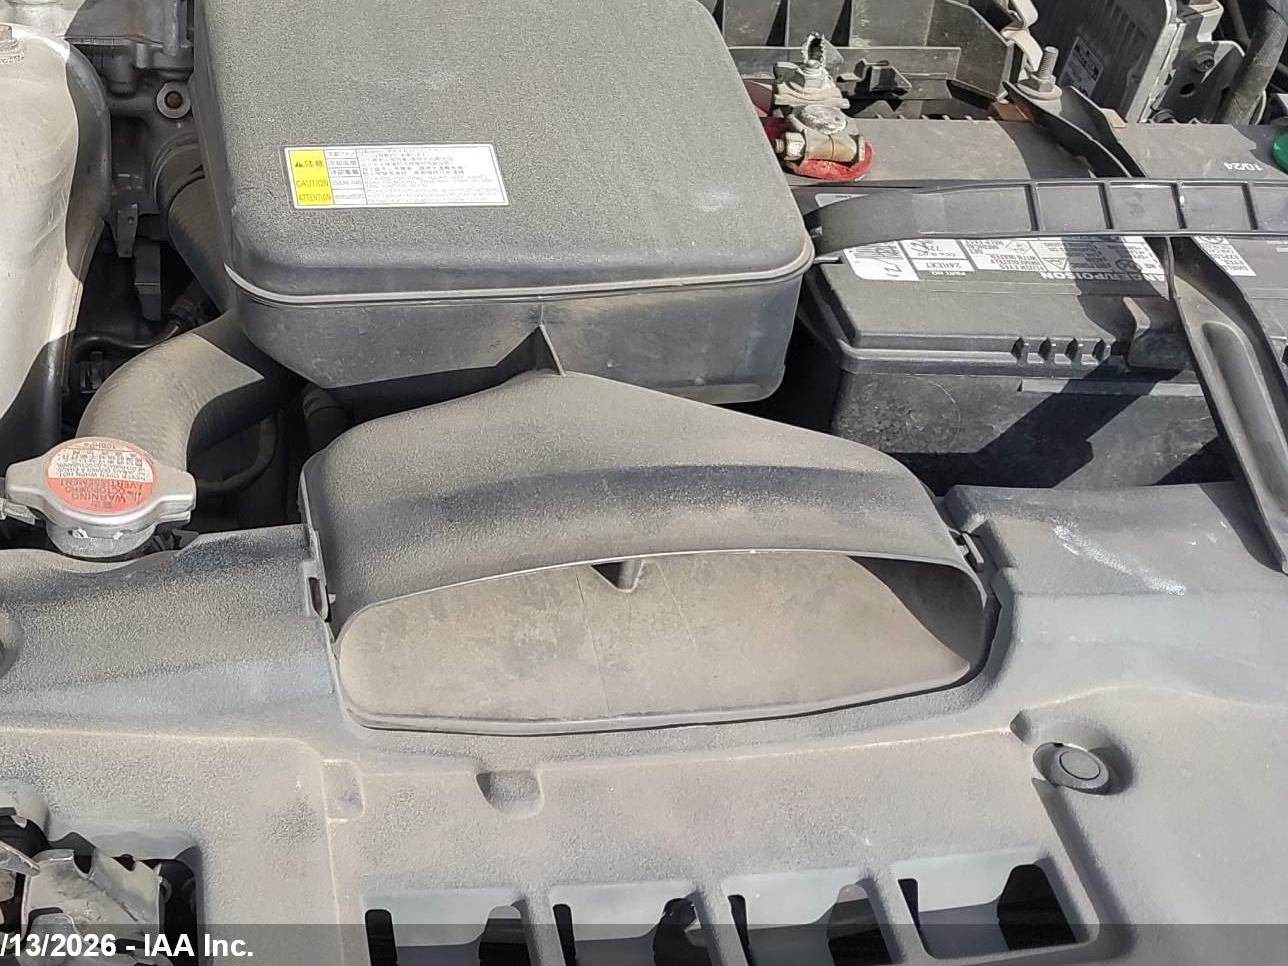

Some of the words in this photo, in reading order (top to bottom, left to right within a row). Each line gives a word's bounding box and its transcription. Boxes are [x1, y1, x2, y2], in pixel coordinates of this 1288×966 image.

[1223, 161, 1264, 172] 10/24
[296, 179, 329, 188] CAUTION
[298, 193, 332, 203] ATTENTION
[1039, 272, 1166, 282] ANGER/POISON
[70, 491, 127, 504] WARNING
